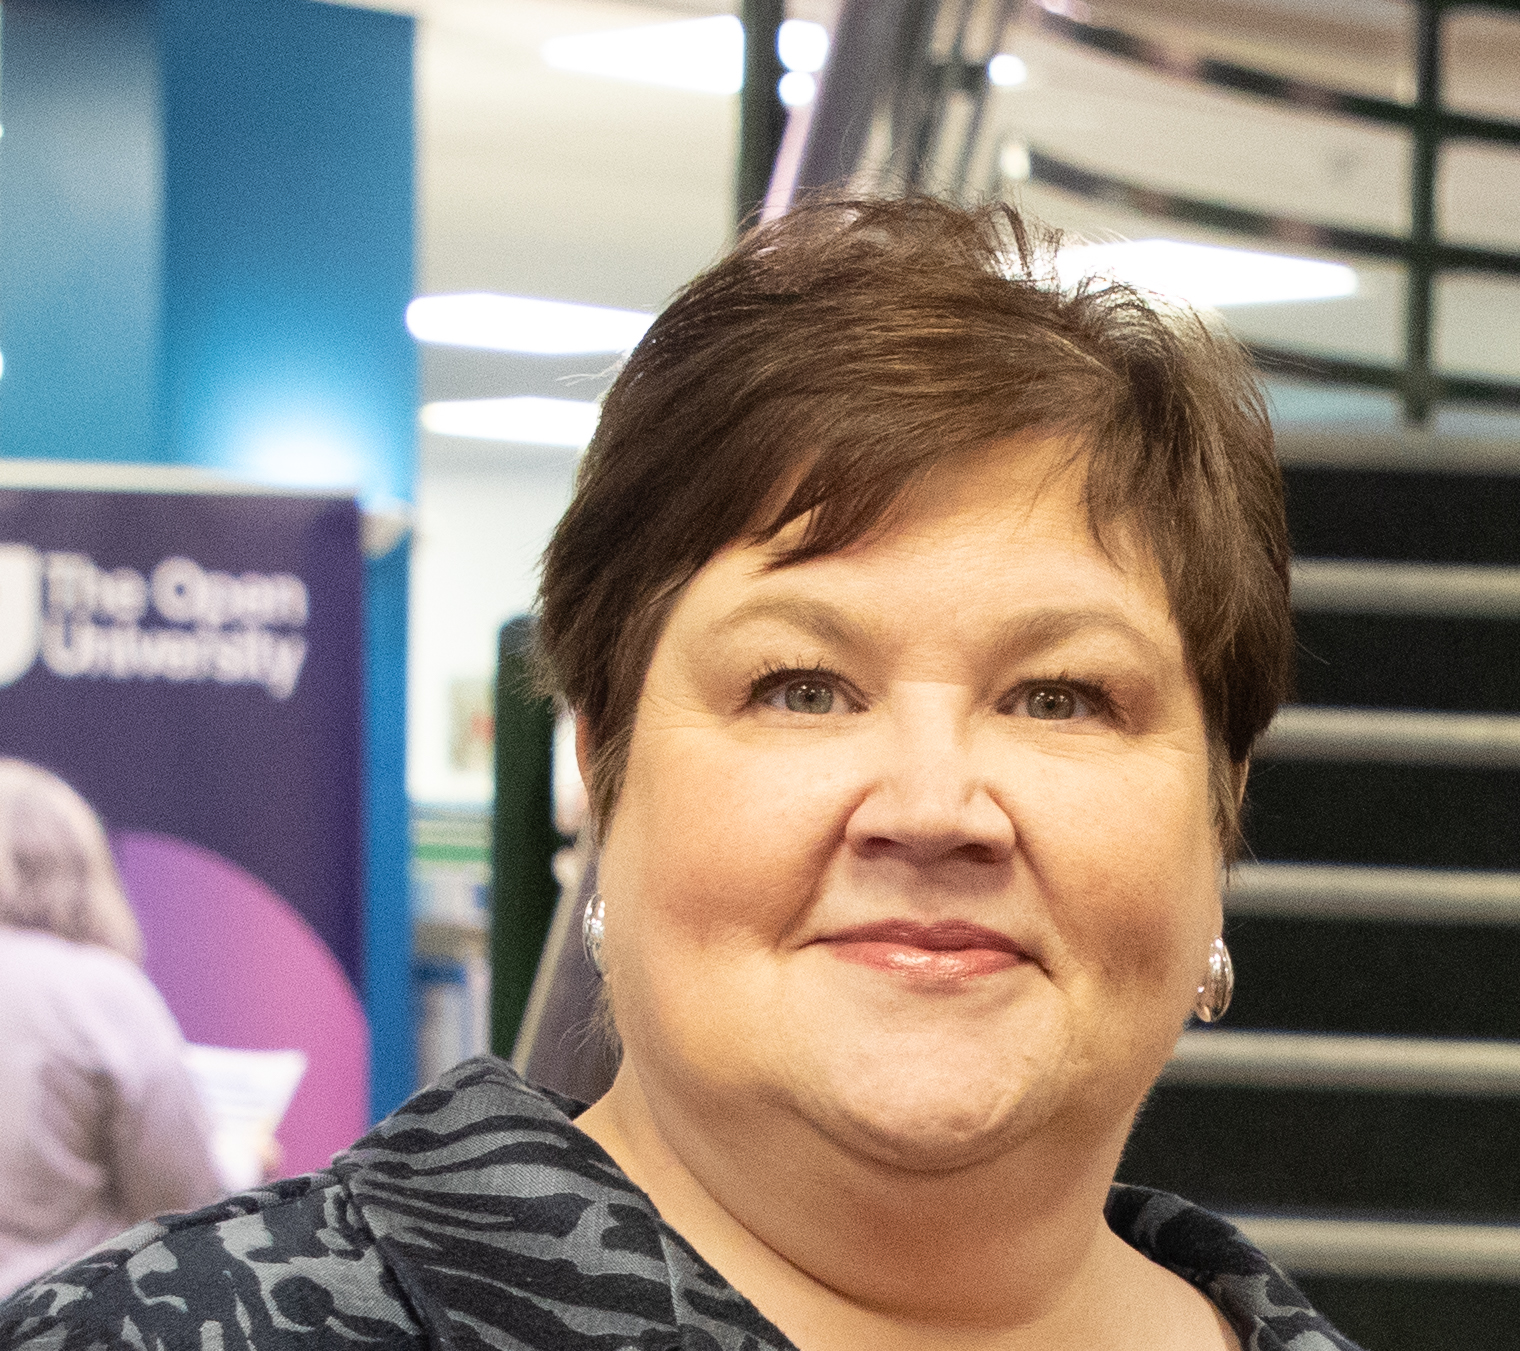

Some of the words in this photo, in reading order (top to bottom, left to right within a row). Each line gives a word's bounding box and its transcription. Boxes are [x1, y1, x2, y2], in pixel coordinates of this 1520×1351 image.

[42, 551, 147, 628] The
[149, 556, 309, 640] Open
[40, 612, 309, 700] University
